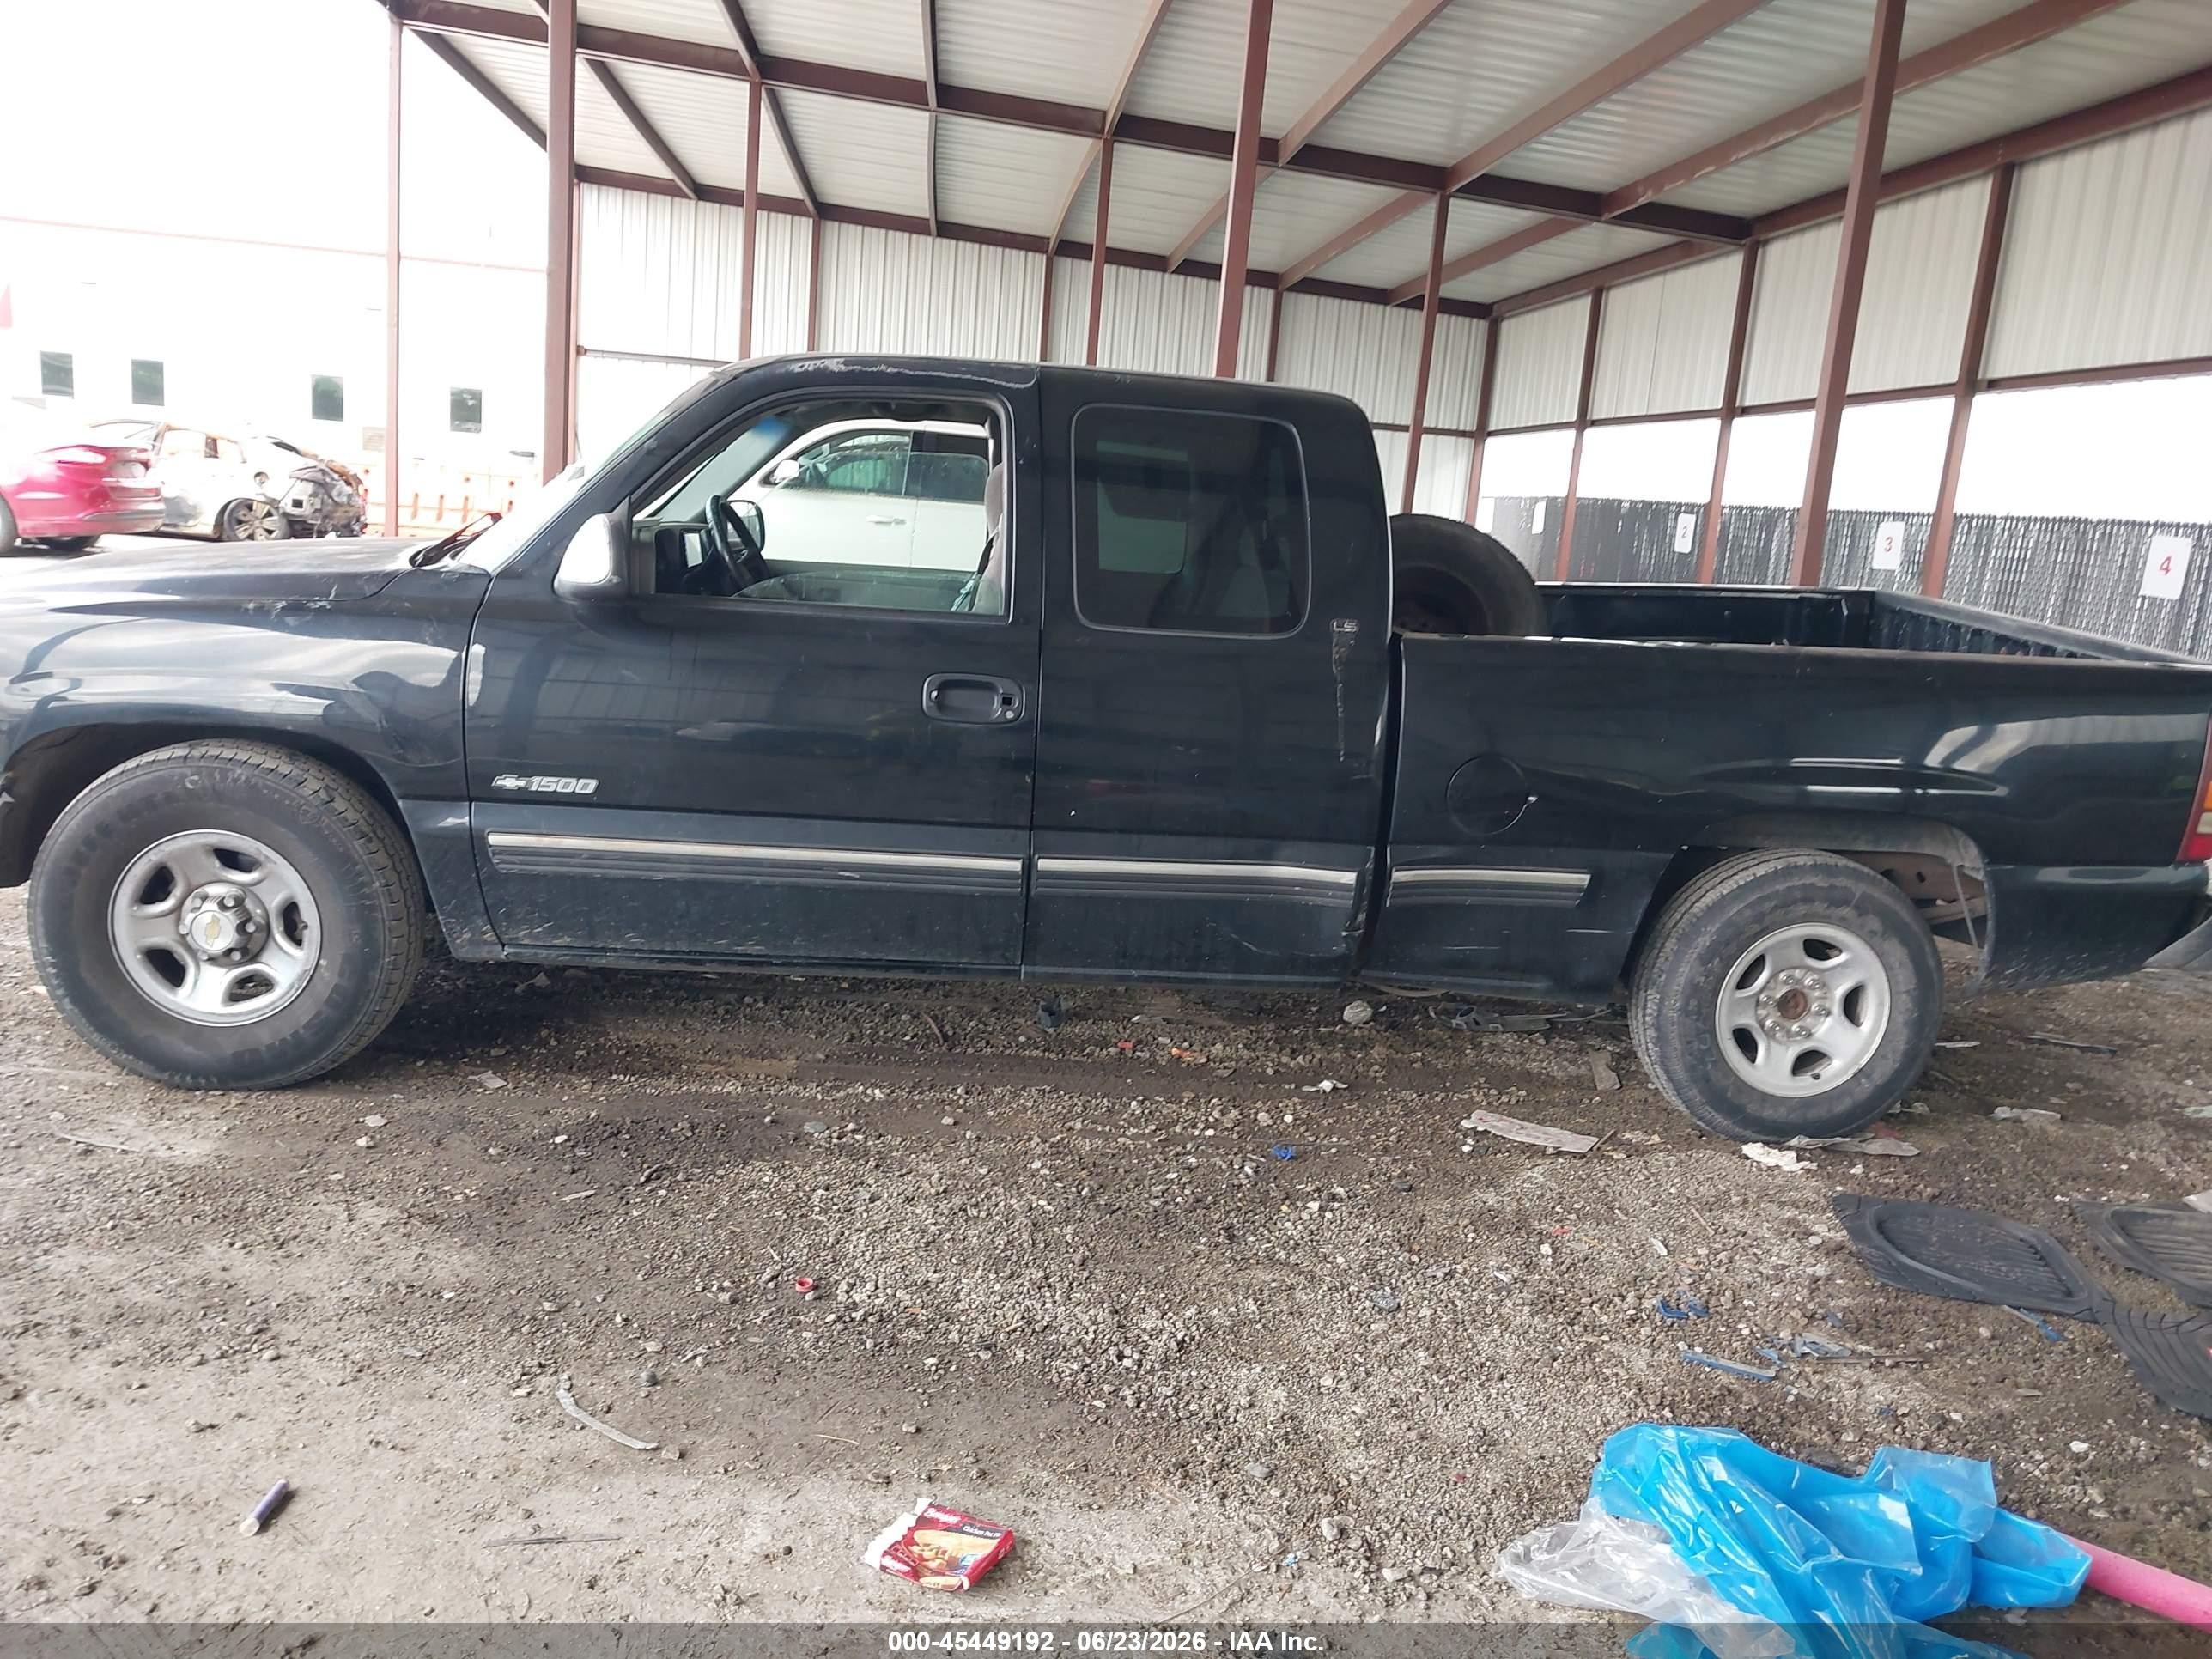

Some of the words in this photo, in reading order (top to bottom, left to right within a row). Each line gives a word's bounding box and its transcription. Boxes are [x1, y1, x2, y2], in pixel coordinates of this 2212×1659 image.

[1681, 526, 1687, 538] 2
[1884, 536, 1893, 552] 3
[2159, 556, 2172, 576] 4
[1333, 619, 1358, 632] LS
[528, 775, 599, 793] 1500
[963, 1525, 984, 1535] Chicken
